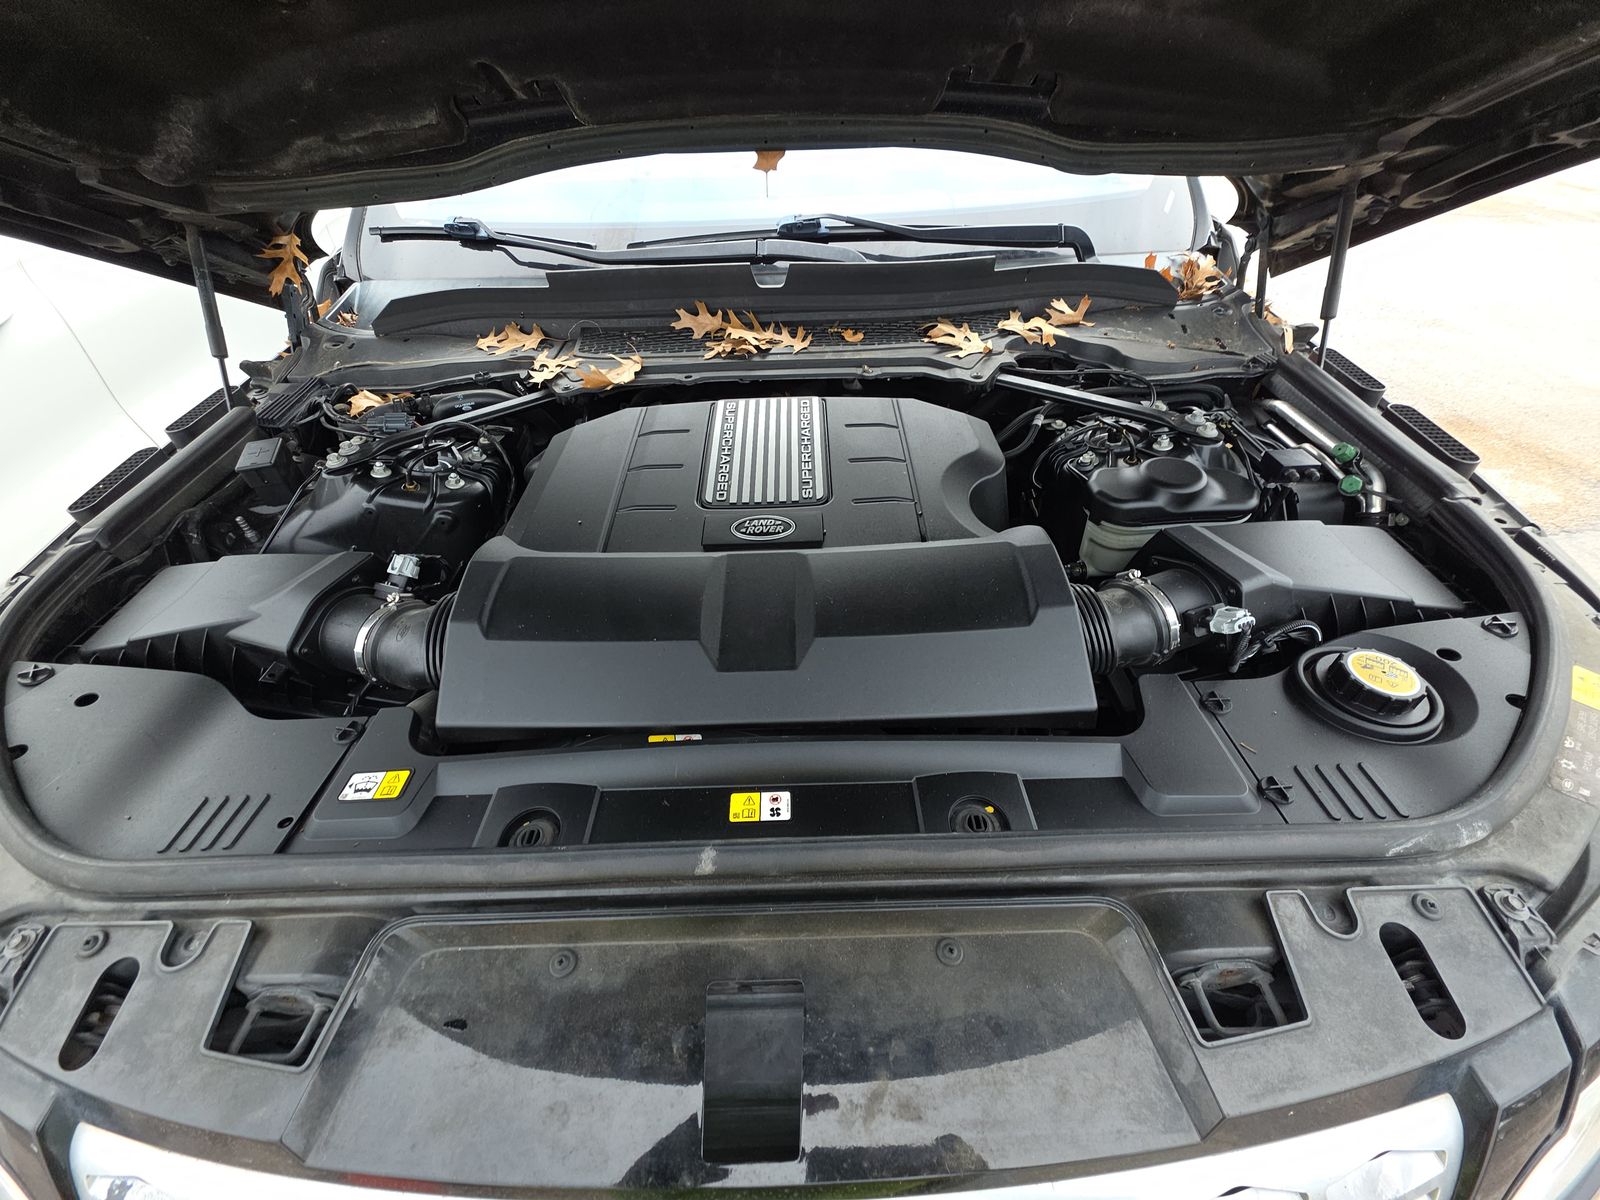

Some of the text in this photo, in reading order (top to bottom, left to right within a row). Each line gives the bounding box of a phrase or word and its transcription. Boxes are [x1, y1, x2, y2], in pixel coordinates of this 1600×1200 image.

[716, 402, 736, 501] SUPERCHARGED
[801, 400, 813, 499] SUPERCHARGED
[744, 519, 775, 527] LAND
[746, 525, 784, 534] ROVER
